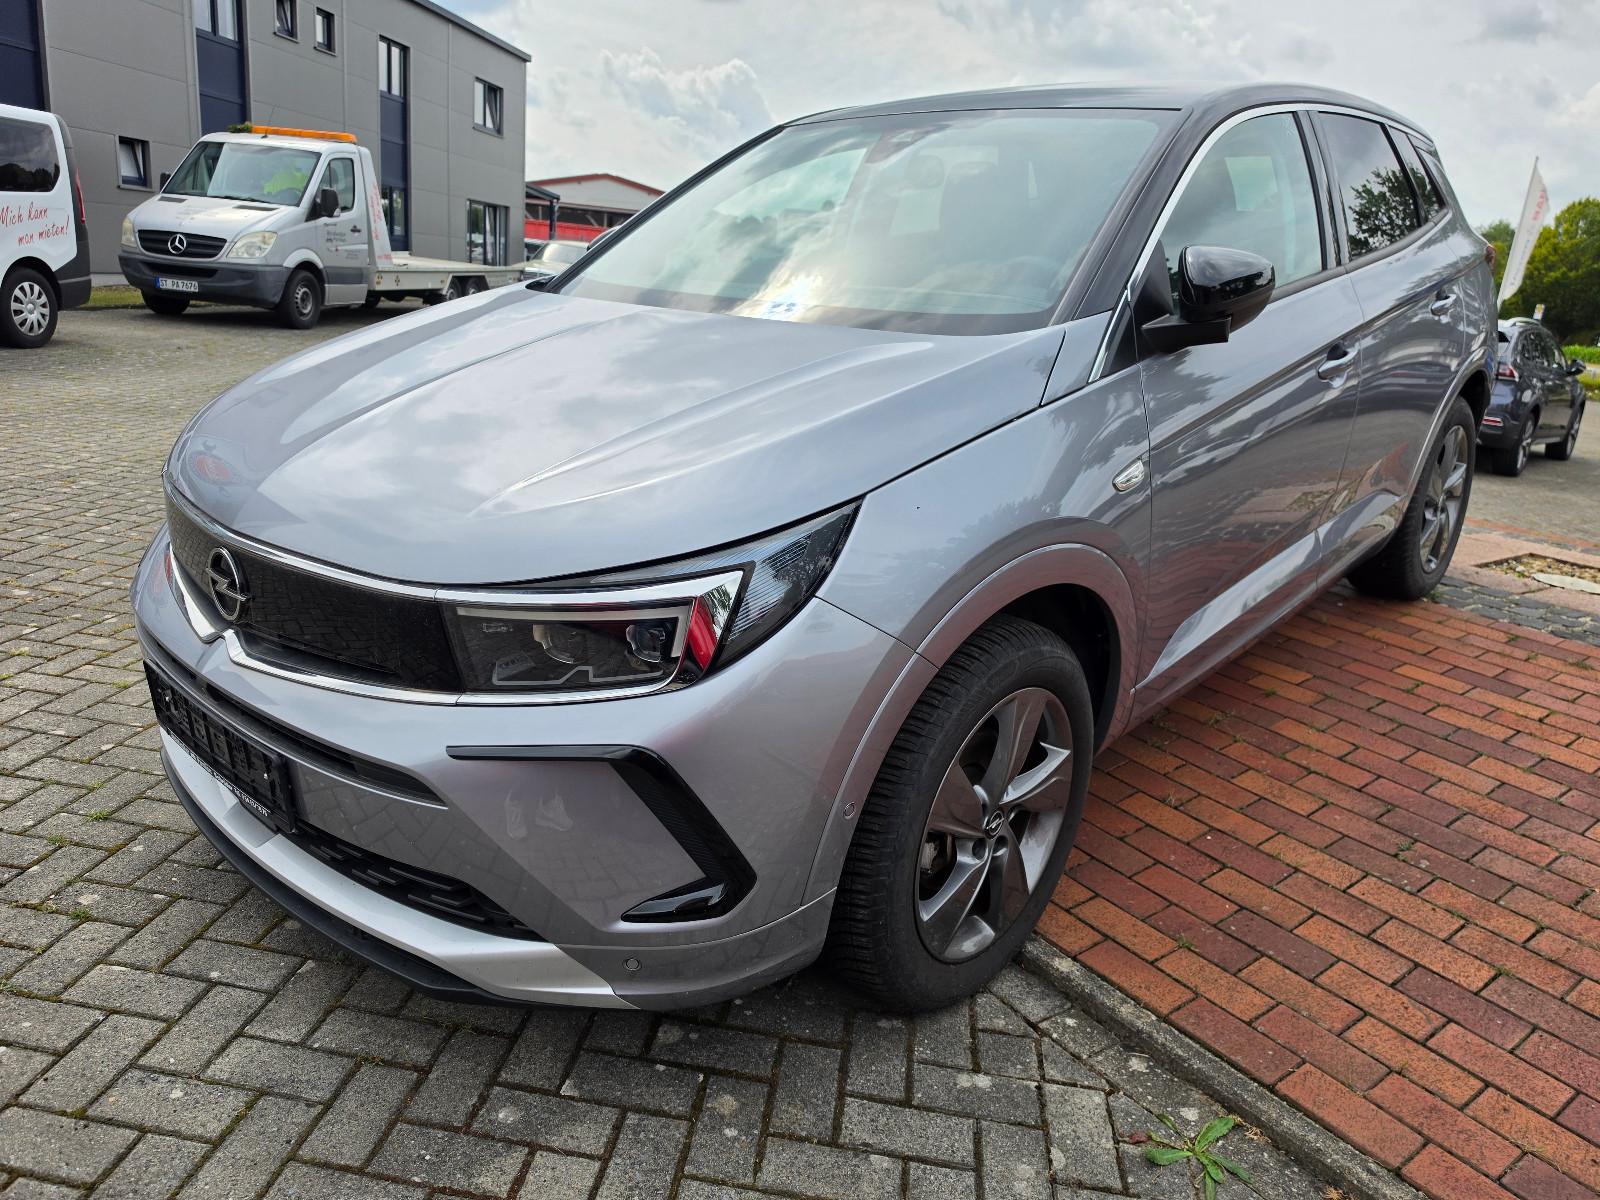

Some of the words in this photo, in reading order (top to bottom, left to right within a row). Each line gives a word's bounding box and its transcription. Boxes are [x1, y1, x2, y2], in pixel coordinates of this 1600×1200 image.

[0, 205, 23, 228] Mich
[28, 201, 48, 221] kann
[18, 233, 34, 246] man
[39, 214, 70, 240] mieten!
[160, 279, 168, 288] ST
[171, 280, 180, 289] PA
